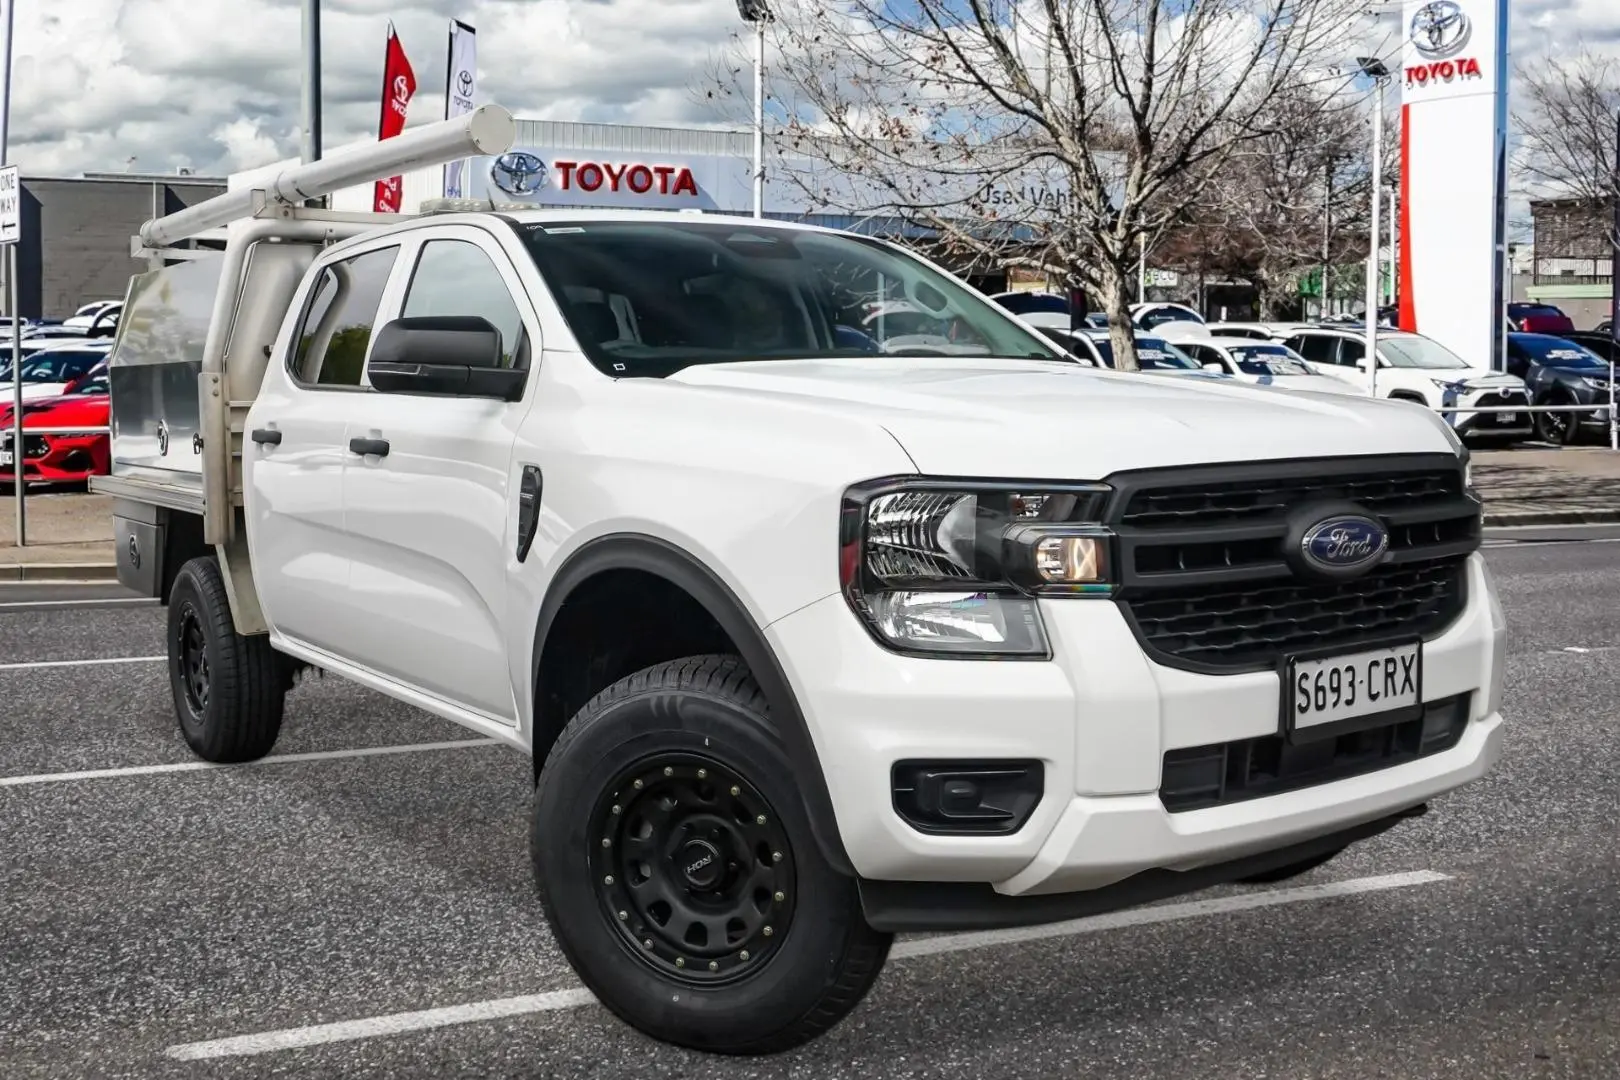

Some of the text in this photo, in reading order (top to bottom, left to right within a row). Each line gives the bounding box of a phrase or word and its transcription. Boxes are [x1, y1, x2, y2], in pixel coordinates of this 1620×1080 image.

[1404, 58, 1480, 83] TOYOTA
[1, 173, 15, 191] ONE
[554, 161, 698, 196] TOYOTA
[0, 196, 16, 213] WAY
[1327, 528, 1371, 558] Ford
